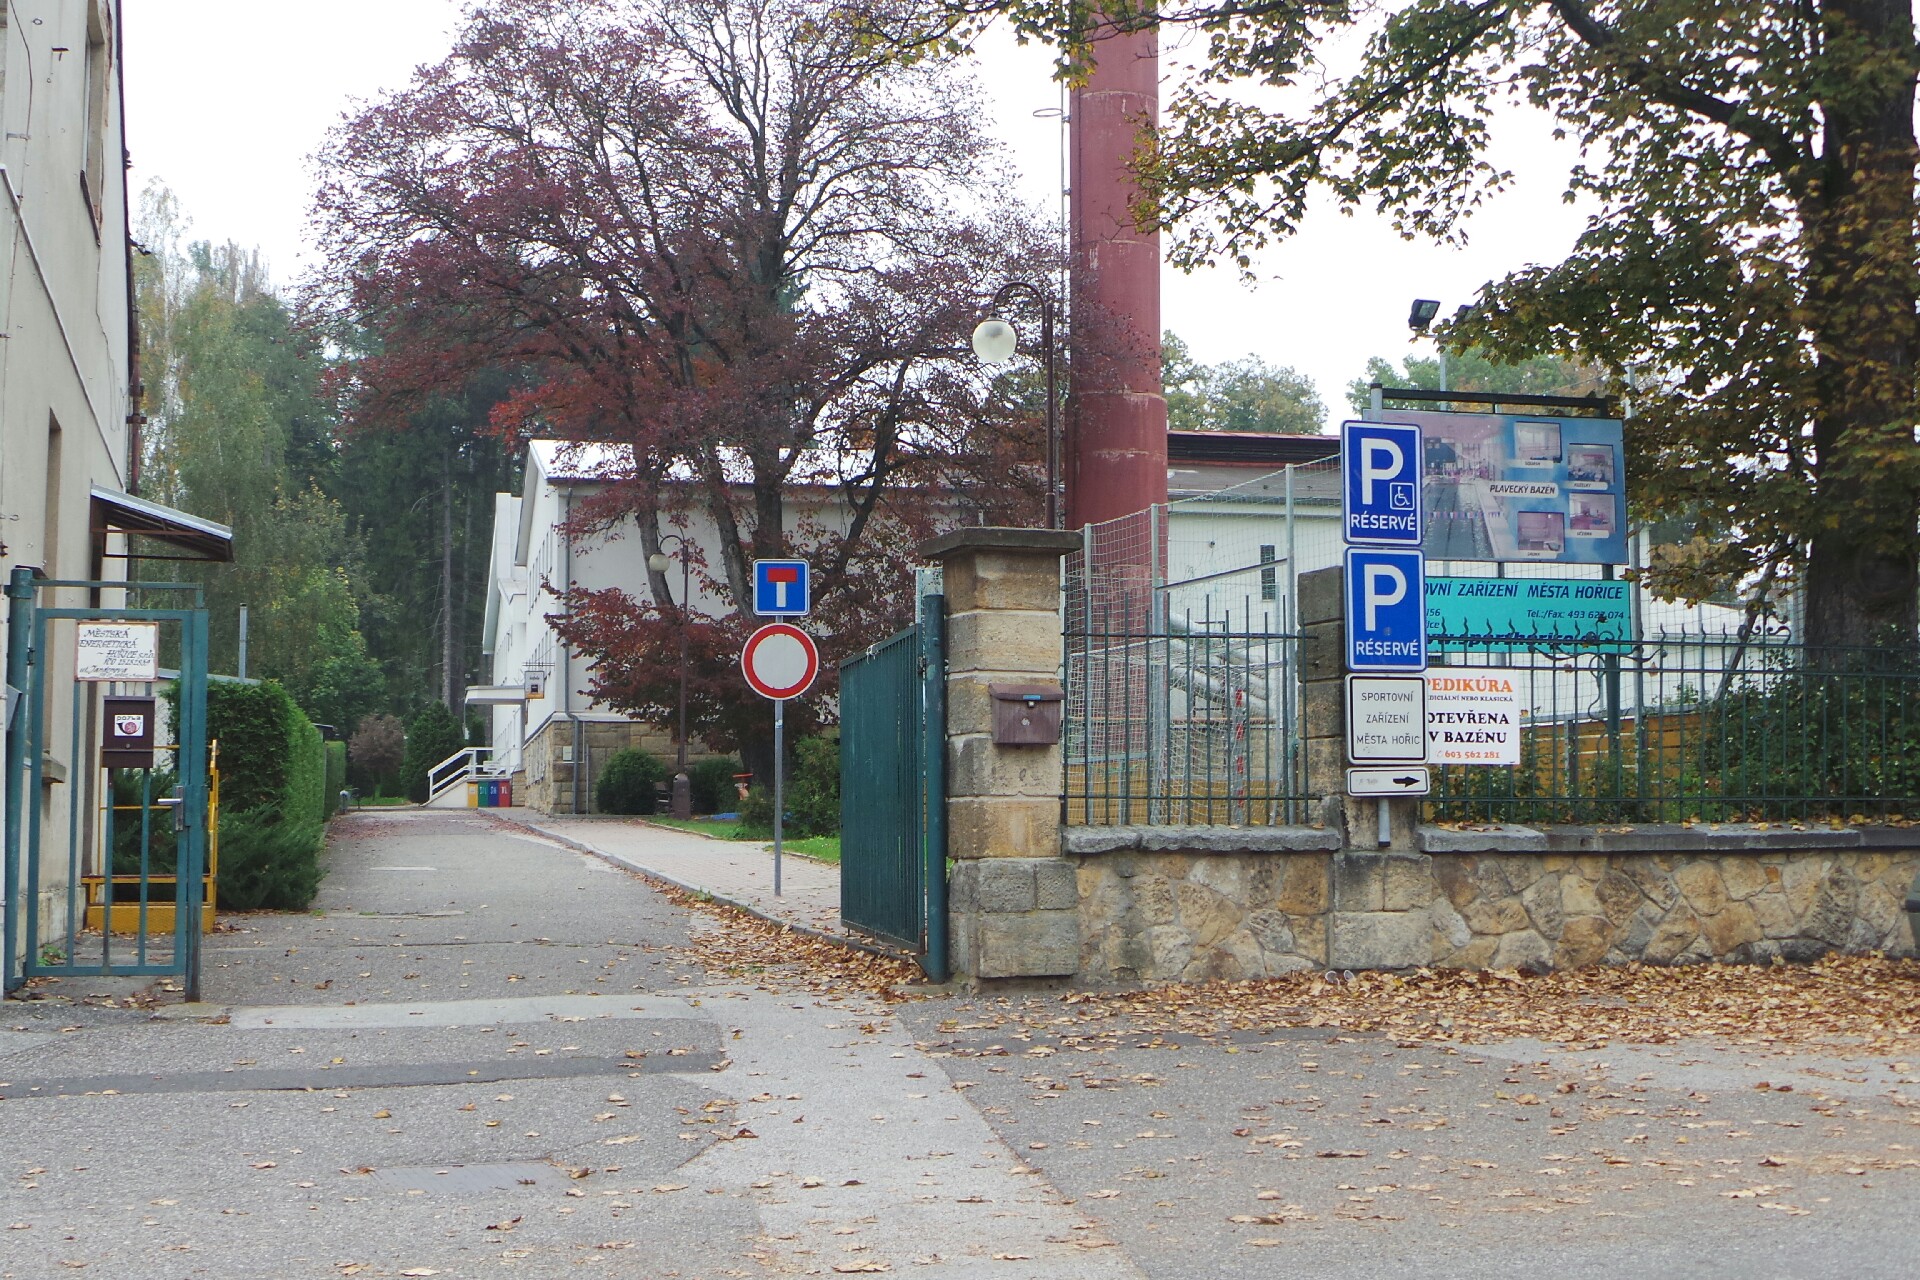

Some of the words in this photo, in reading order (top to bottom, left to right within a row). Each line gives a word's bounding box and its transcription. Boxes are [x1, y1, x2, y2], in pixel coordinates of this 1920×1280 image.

[1361, 437, 1404, 505] P
[1490, 484, 1530, 494] PLAVECKÝ
[1530, 484, 1556, 495] BAZÉN
[1350, 511, 1416, 531] RÉSERVÉ
[1457, 581, 1519, 598] ZAŘÍZENÍ
[1527, 582, 1570, 599] MĚSTA
[1574, 583, 1624, 600] HOŘICE
[1364, 563, 1407, 632] P
[1567, 610, 1586, 619] 493
[1607, 611, 1624, 620] 074
[84, 627, 130, 639] MĚSTSKÁ
[80, 638, 139, 649] ENERGETICKÁ
[1356, 638, 1419, 656] RÉSERVÉ
[1361, 691, 1414, 702] SPORTOVNÍ
[1365, 712, 1410, 724] ZAŘÍZENÍ
[1428, 709, 1510, 725] OTEVŘENA
[1356, 732, 1388, 745] MĚSTA
[1391, 732, 1421, 745] HOŘIC
[1428, 731, 1440, 743] V
[1444, 728, 1507, 744] BAZÉNU
[1444, 750, 1462, 758] 603
[1464, 750, 1481, 759] 562
[1484, 750, 1500, 758] 281
